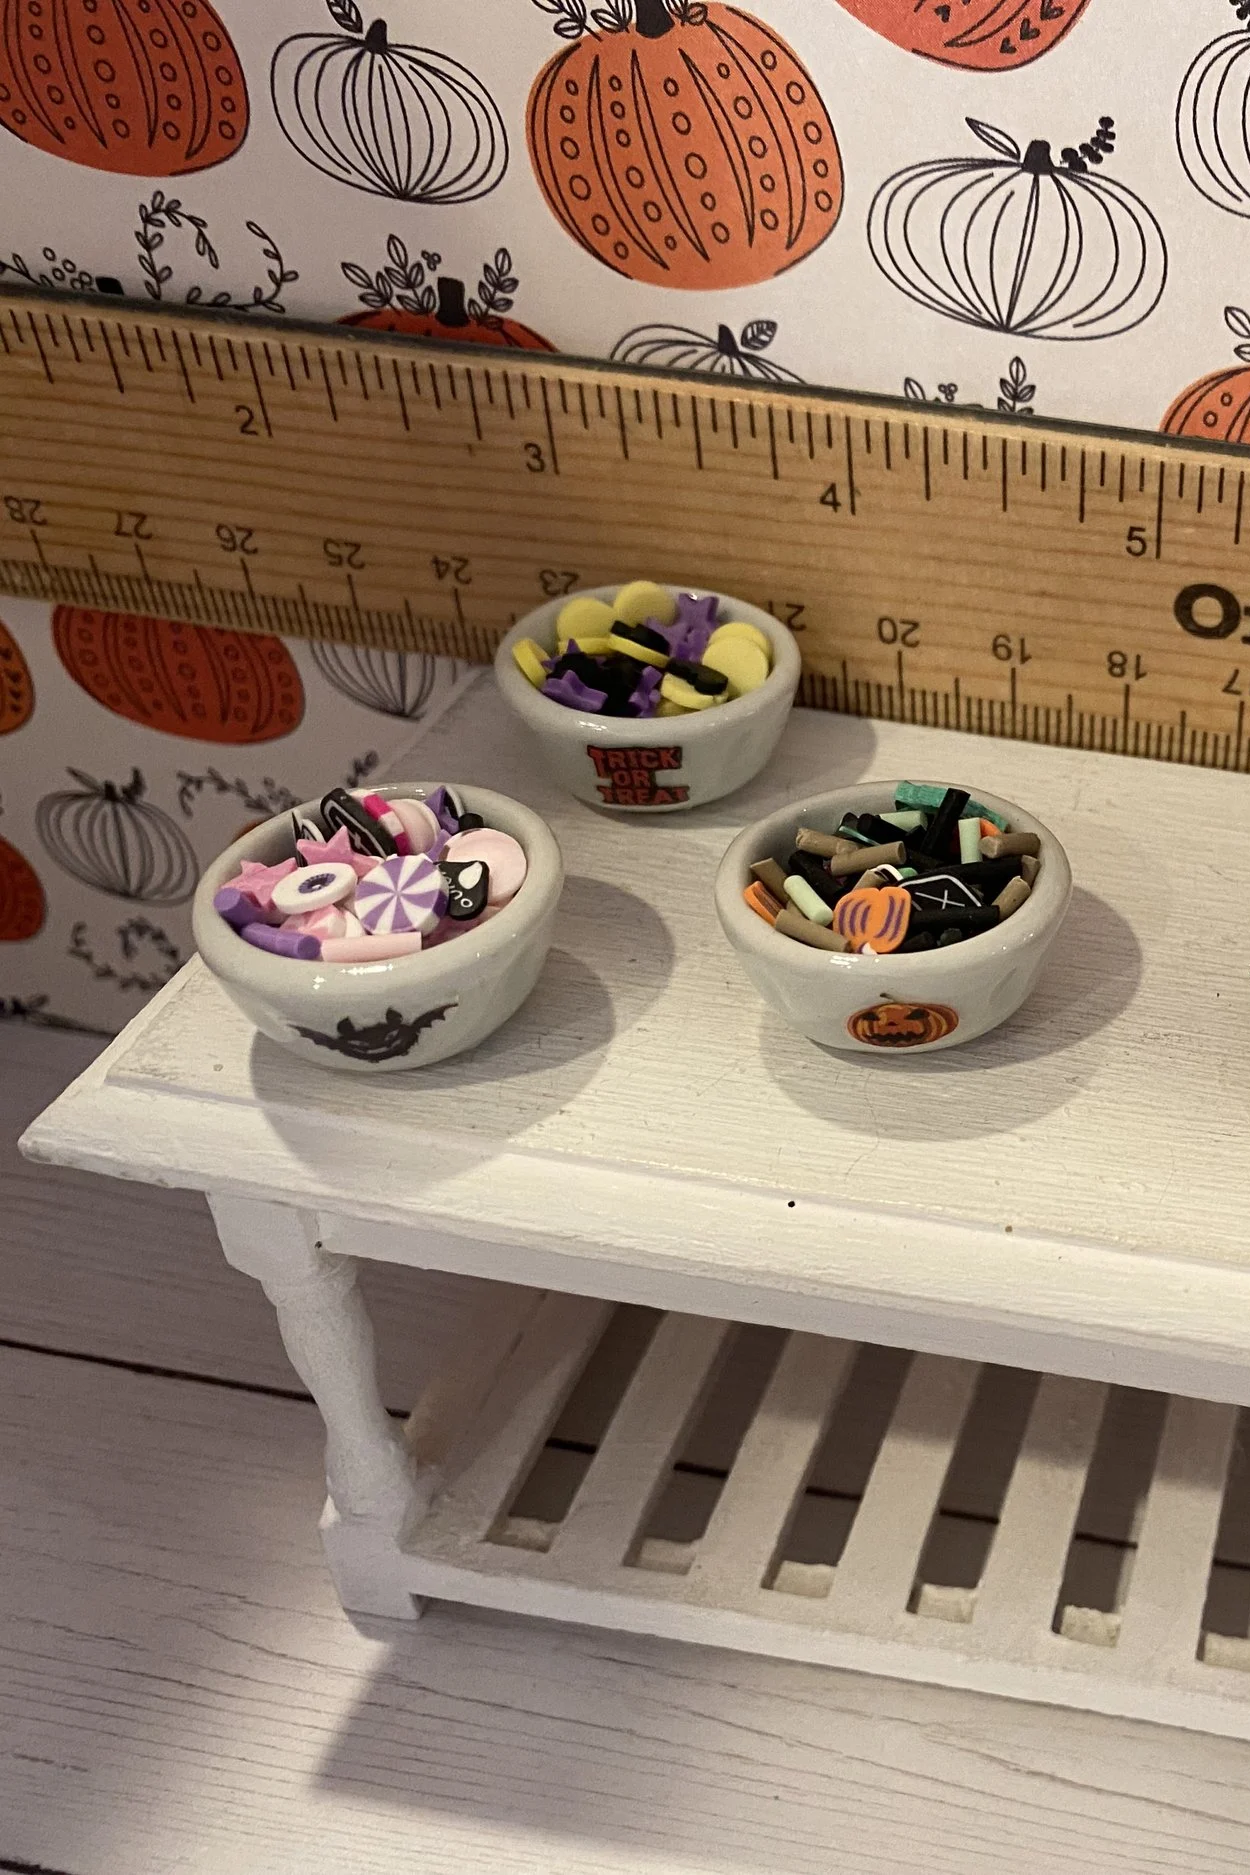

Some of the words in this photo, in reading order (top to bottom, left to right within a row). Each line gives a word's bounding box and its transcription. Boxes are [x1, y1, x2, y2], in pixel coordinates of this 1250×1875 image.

[234, 405, 258, 436] 2
[525, 443, 546, 474] 3
[7, 494, 48, 527] 28
[819, 482, 842, 513] 4
[113, 510, 154, 541] 27
[215, 523, 259, 556] 26
[1125, 525, 1148, 558] 5
[322, 537, 366, 570] 25
[431, 554, 473, 586] 24
[539, 569, 580, 595] 23
[877, 616, 920, 648] 20
[991, 633, 1033, 665] 19
[1106, 650, 1148, 682] 18
[587, 745, 683, 779] TRICK
[612, 769, 651, 787] OR
[597, 785, 690, 805] TREAT
